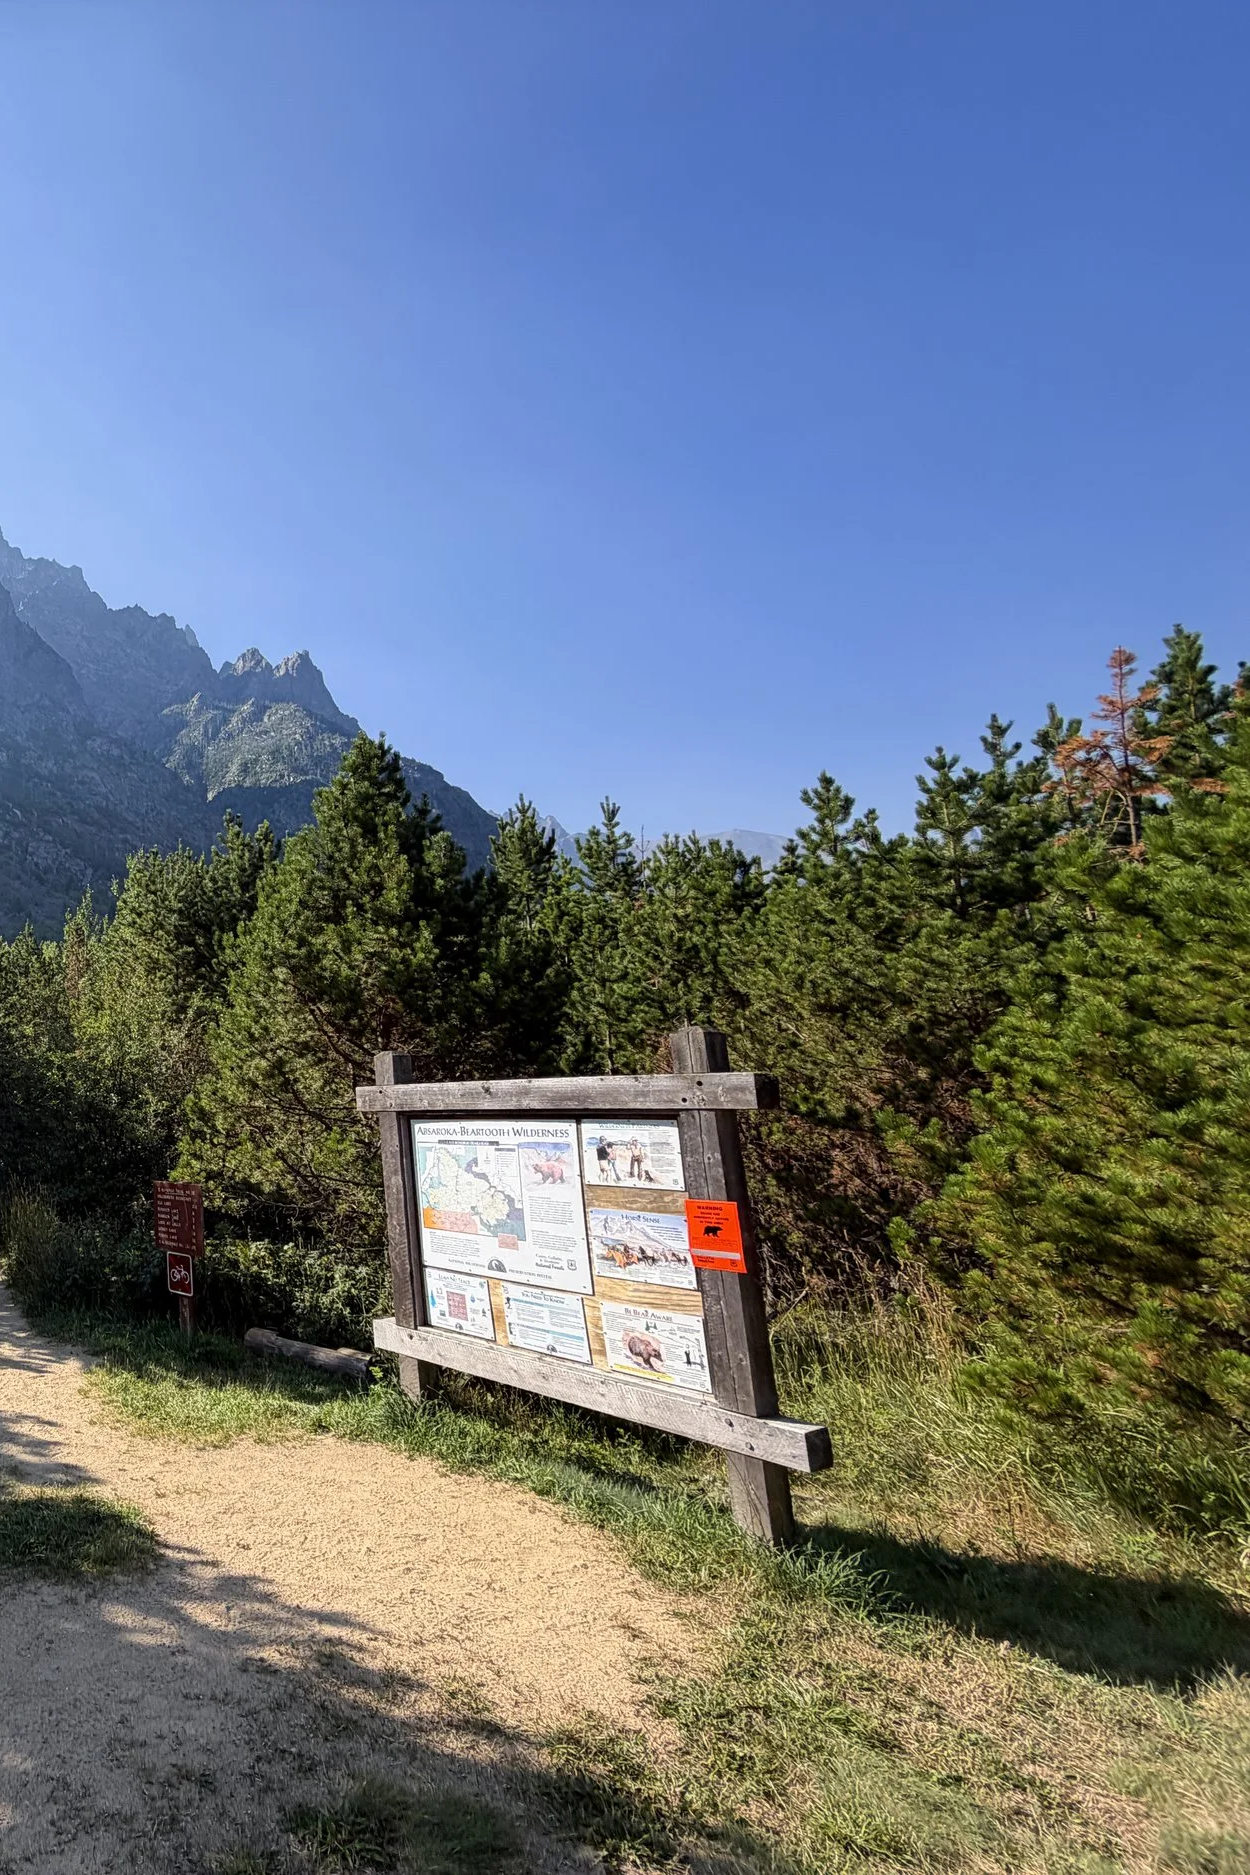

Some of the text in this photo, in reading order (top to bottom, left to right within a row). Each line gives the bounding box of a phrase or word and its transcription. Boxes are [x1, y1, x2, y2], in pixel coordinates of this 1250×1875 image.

[417, 1126, 570, 1138] ABSAROKA-BEARTOOTH WILDERNESS
[642, 1216, 661, 1224] SENSE
[651, 1313, 673, 1321] AWARE
